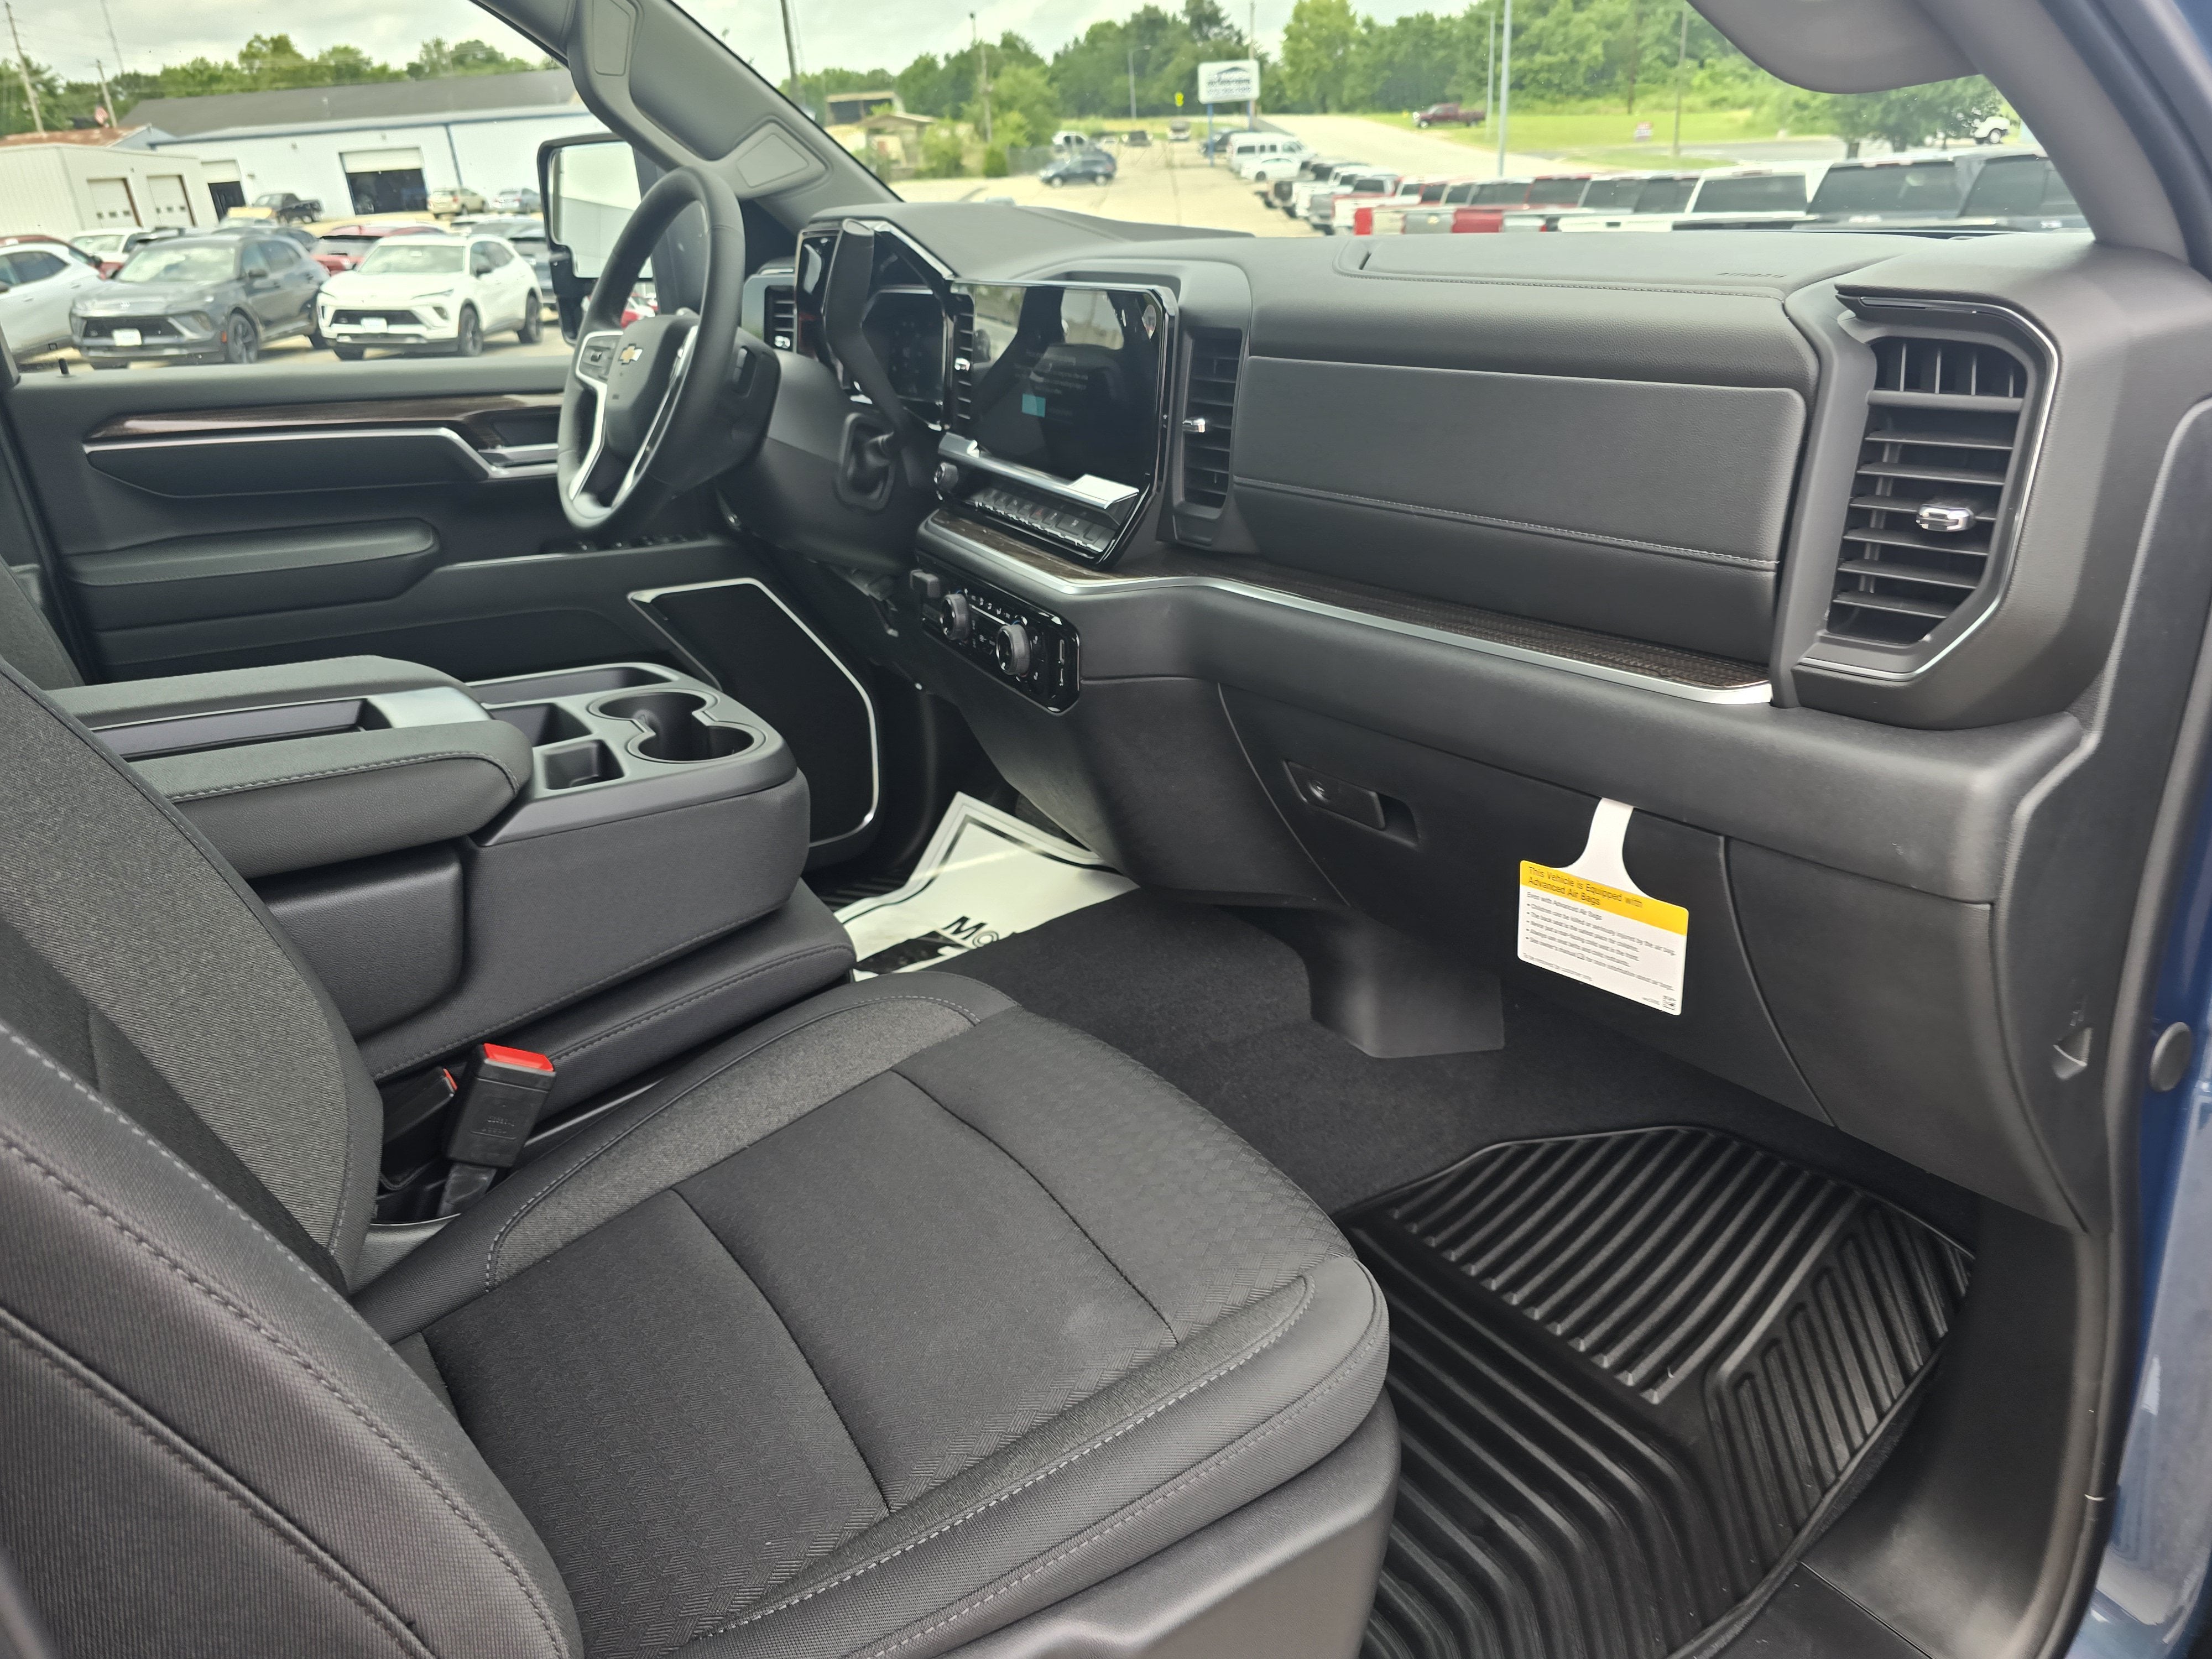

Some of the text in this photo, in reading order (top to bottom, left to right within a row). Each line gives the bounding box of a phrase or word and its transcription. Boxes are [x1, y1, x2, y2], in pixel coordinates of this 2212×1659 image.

[1528, 866, 1643, 907] This Vehicle is Equipped with
[1528, 877, 1600, 906] Advanced Air Bags
